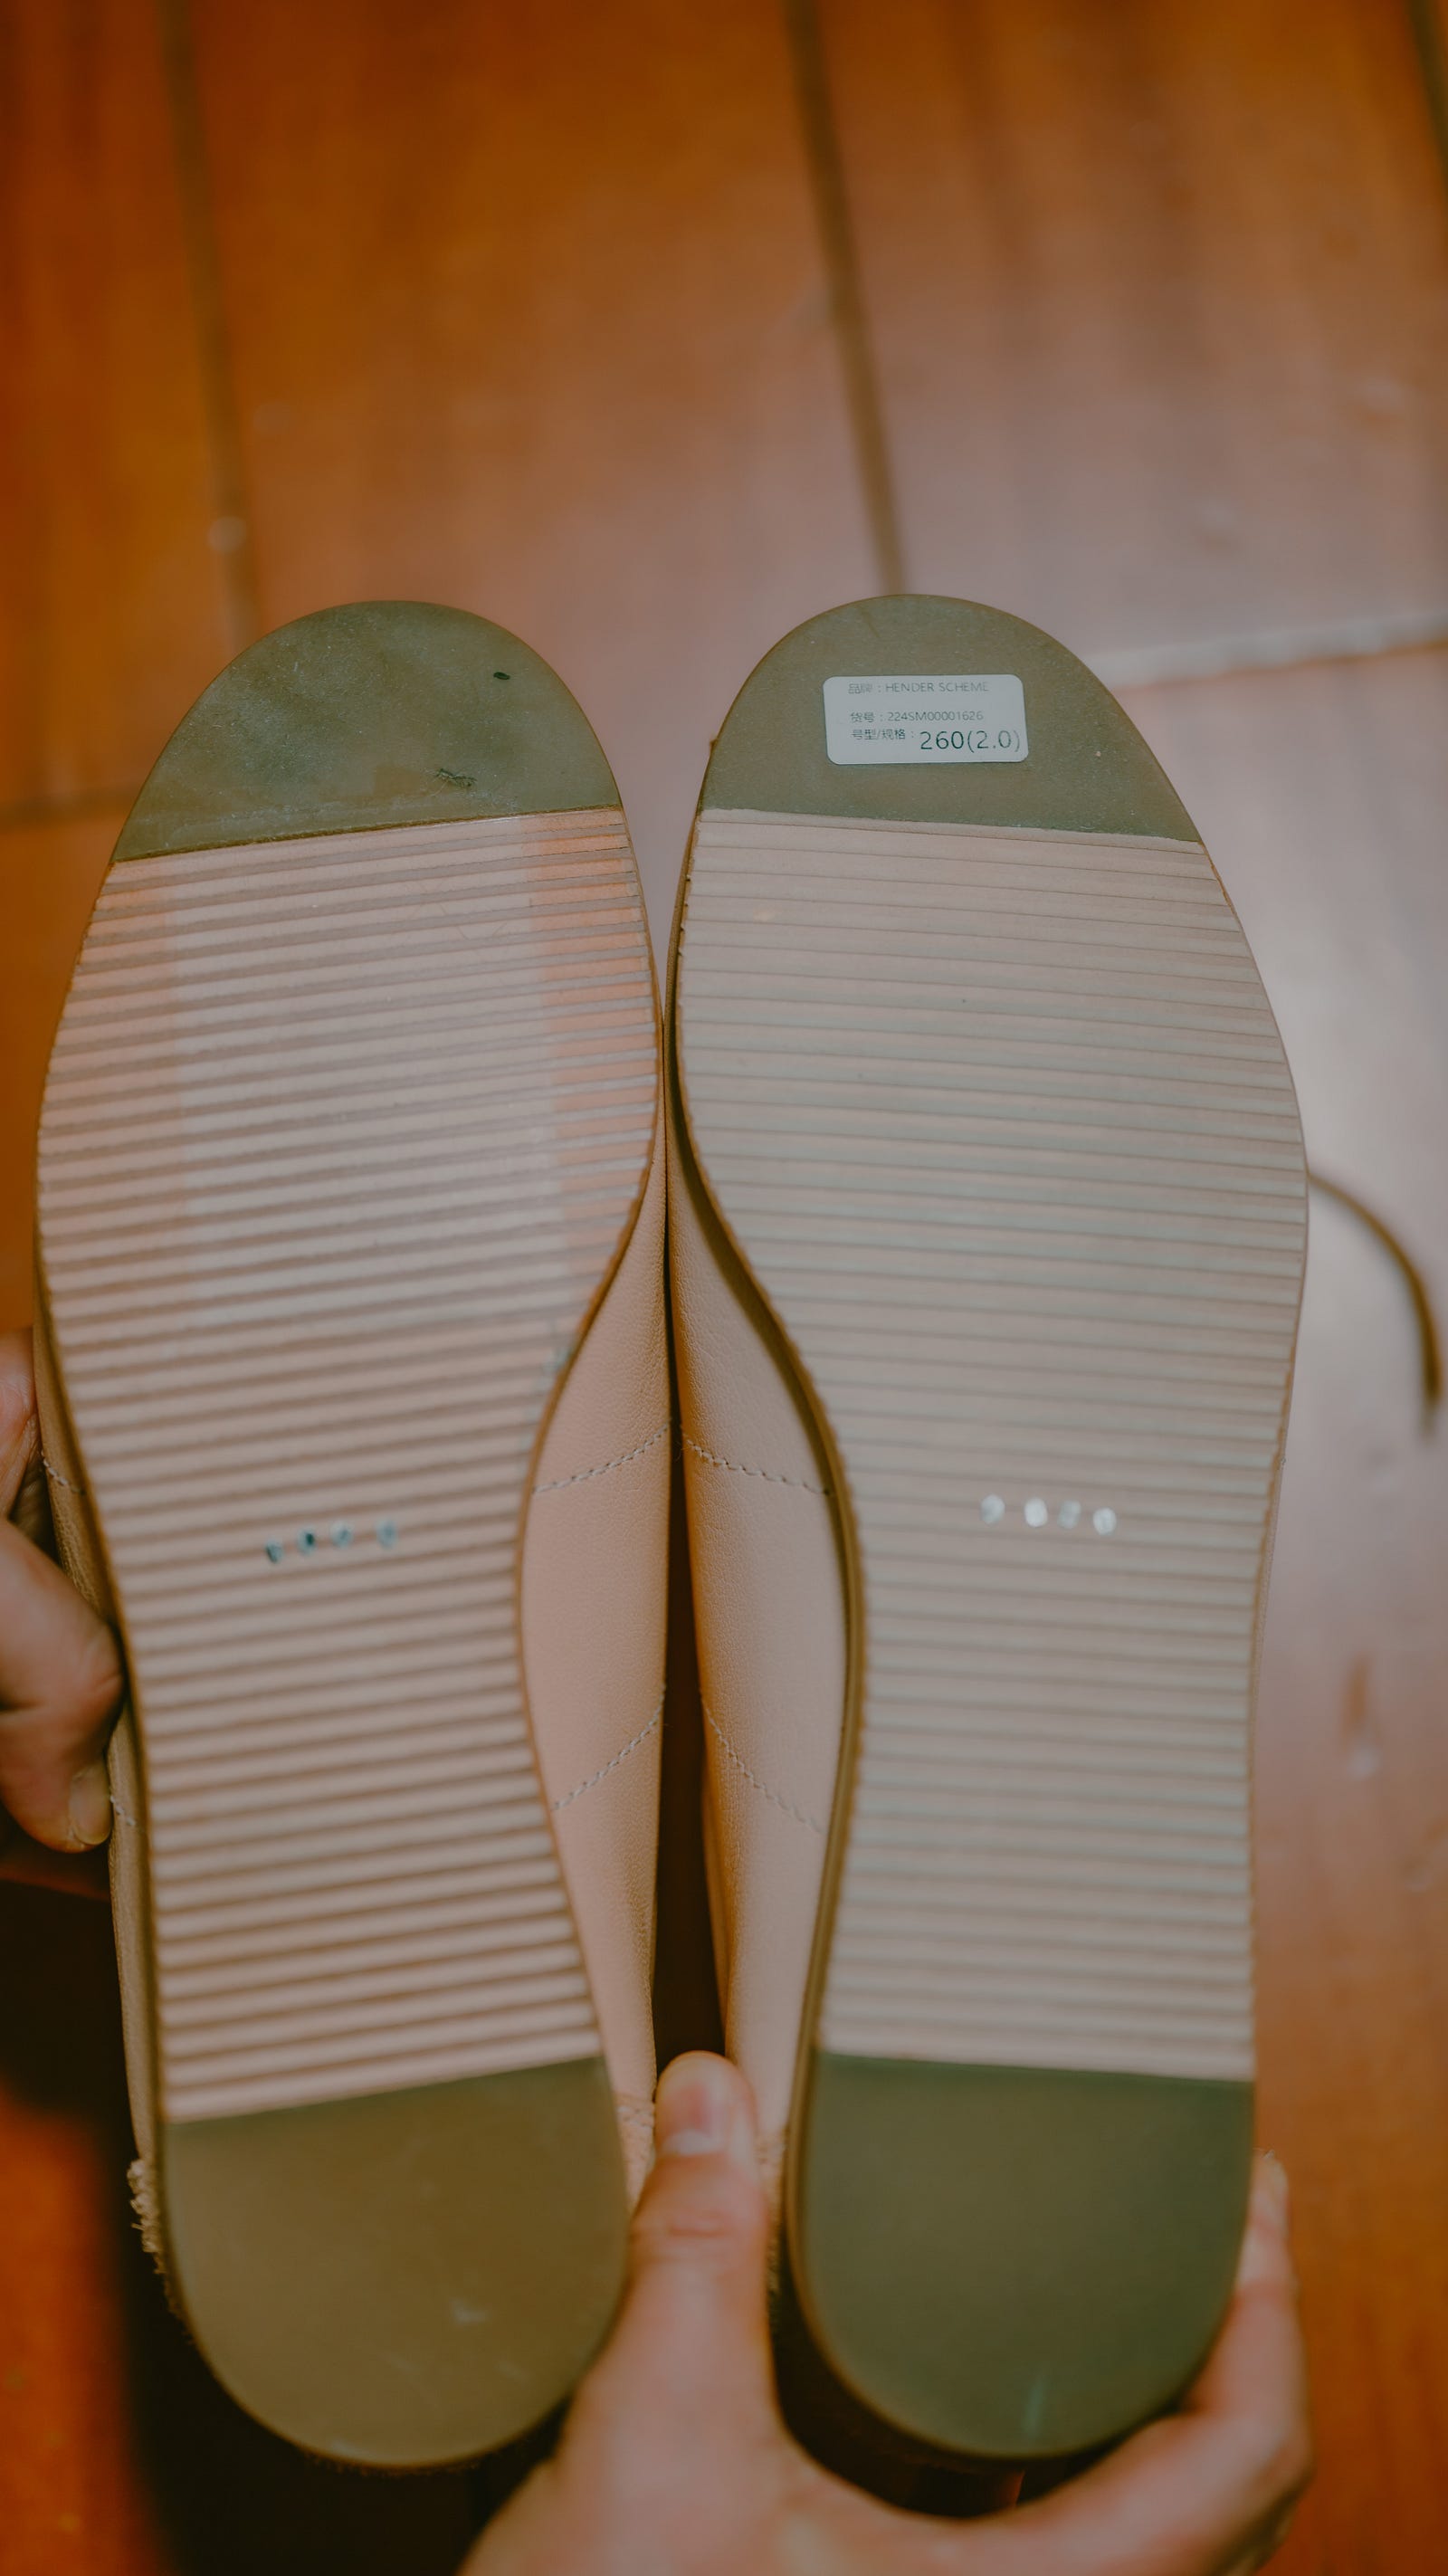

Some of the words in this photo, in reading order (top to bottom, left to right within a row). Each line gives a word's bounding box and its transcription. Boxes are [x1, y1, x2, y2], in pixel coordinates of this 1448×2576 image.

[885, 682, 935, 692] HENDER
[938, 682, 989, 692] SCHEME
[887, 711, 984, 722] 224SM00001626
[919, 730, 1021, 753] 260(2.0)
